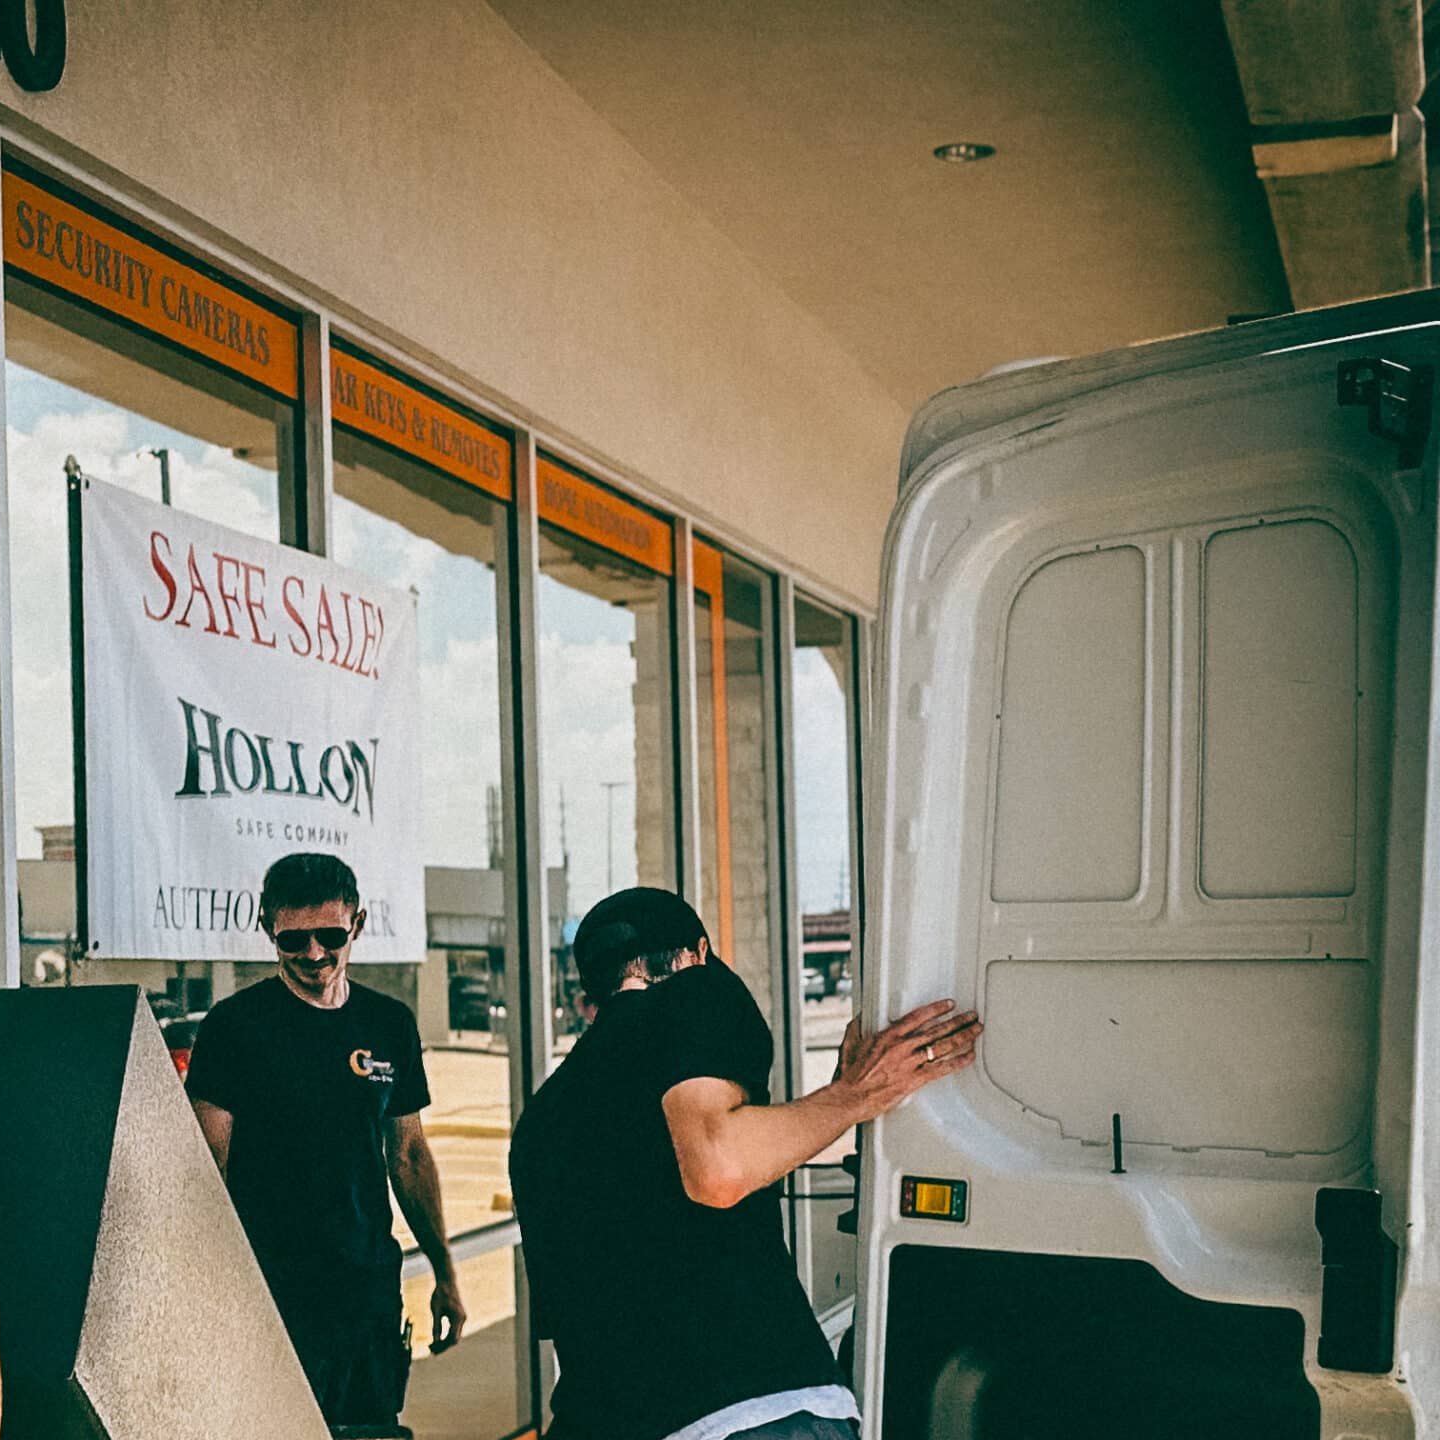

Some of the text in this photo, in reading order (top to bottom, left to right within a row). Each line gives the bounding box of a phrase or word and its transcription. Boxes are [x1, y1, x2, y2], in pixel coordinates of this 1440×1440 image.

[16, 200, 271, 366] SECURITY CAMERAS
[332, 366, 359, 411] AR
[364, 381, 407, 434] KEYS
[412, 407, 426, 443] &
[143, 530, 385, 681] SAFE SALE!
[174, 696, 380, 827] HOLLON
[236, 817, 349, 847] SAFE COMPANY
